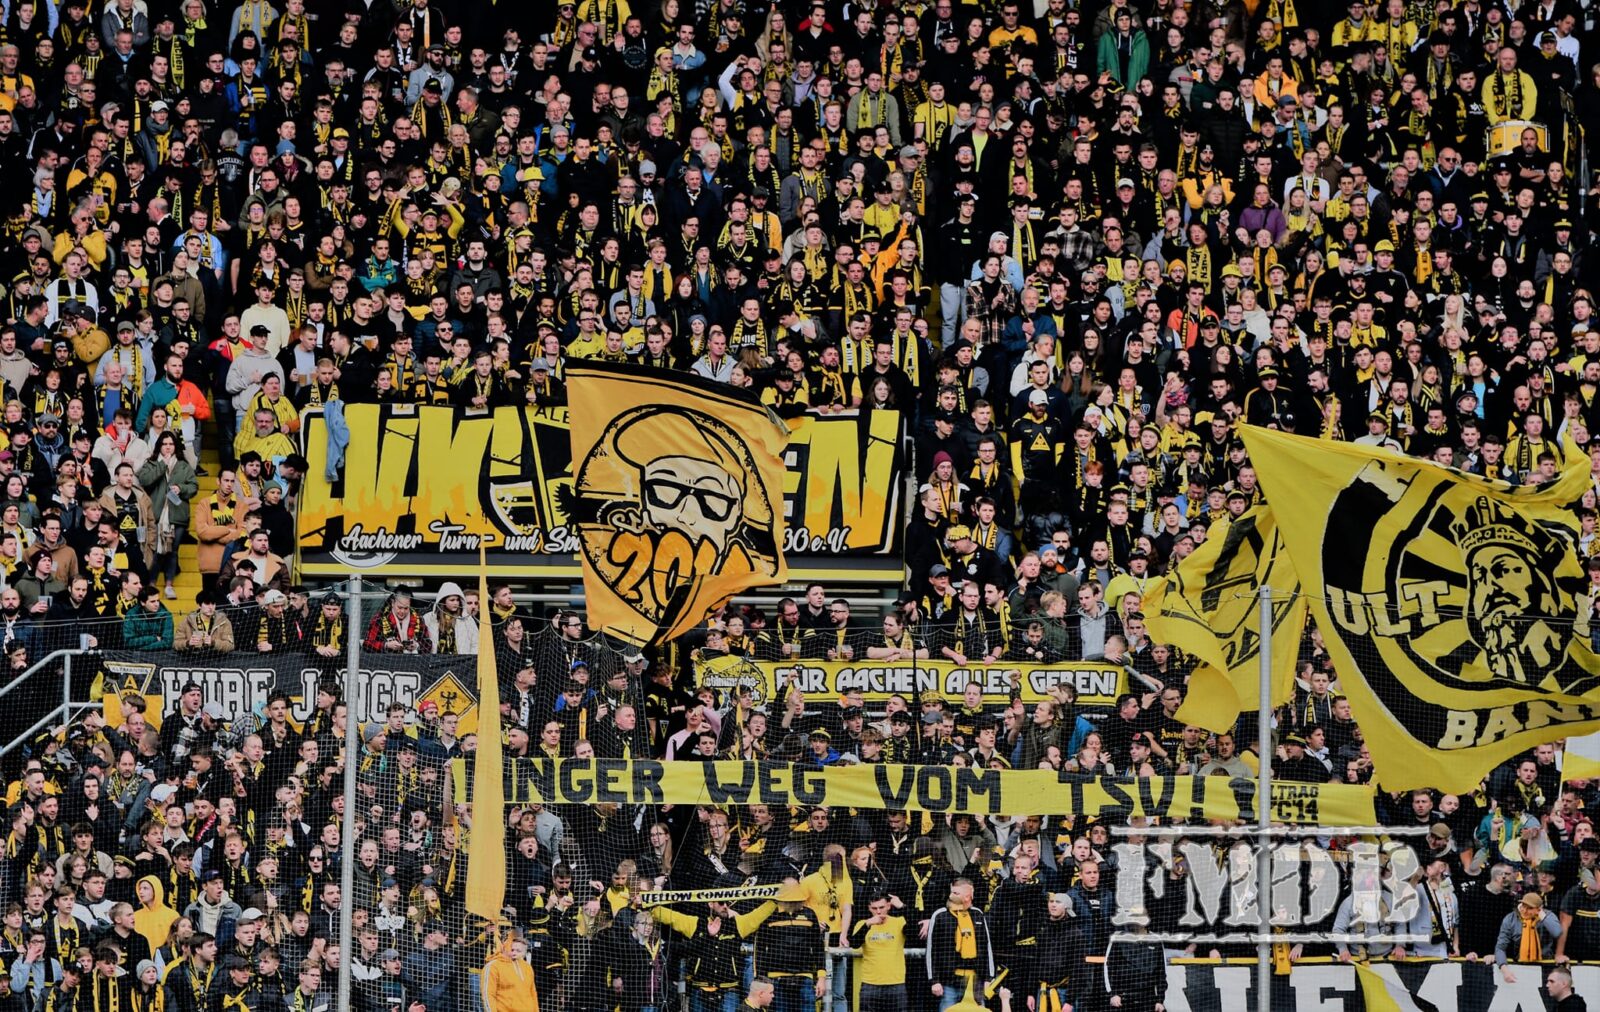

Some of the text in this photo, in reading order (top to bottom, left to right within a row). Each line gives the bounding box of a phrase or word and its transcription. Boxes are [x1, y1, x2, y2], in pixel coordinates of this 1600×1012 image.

[341, 524, 423, 551] Aachener
[429, 521, 494, 551] Turn-
[504, 528, 541, 552] und
[836, 667, 938, 693] AACHEN
[1437, 698, 1600, 750] BAN
[702, 760, 826, 806] WEG
[874, 764, 1001, 814] VOM
[1057, 771, 1206, 818] TSV!
[641, 891, 692, 904] YELLOW
